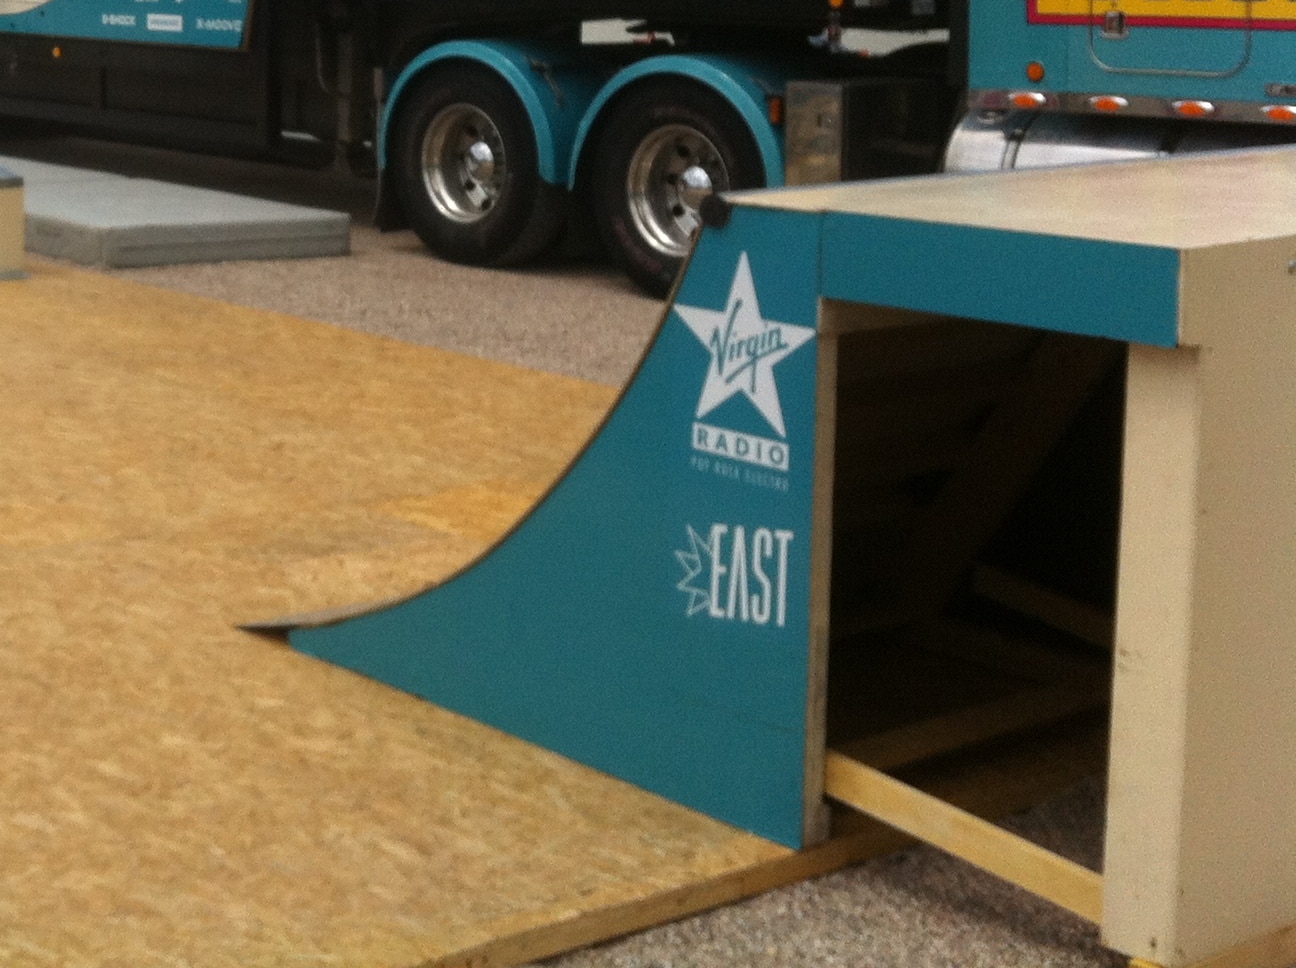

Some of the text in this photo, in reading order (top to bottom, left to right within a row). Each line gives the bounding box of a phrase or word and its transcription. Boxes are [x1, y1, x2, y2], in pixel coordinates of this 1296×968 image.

[710, 298, 789, 394] Virgin
[697, 426, 786, 467] RADIO
[708, 522, 795, 628] EAST
